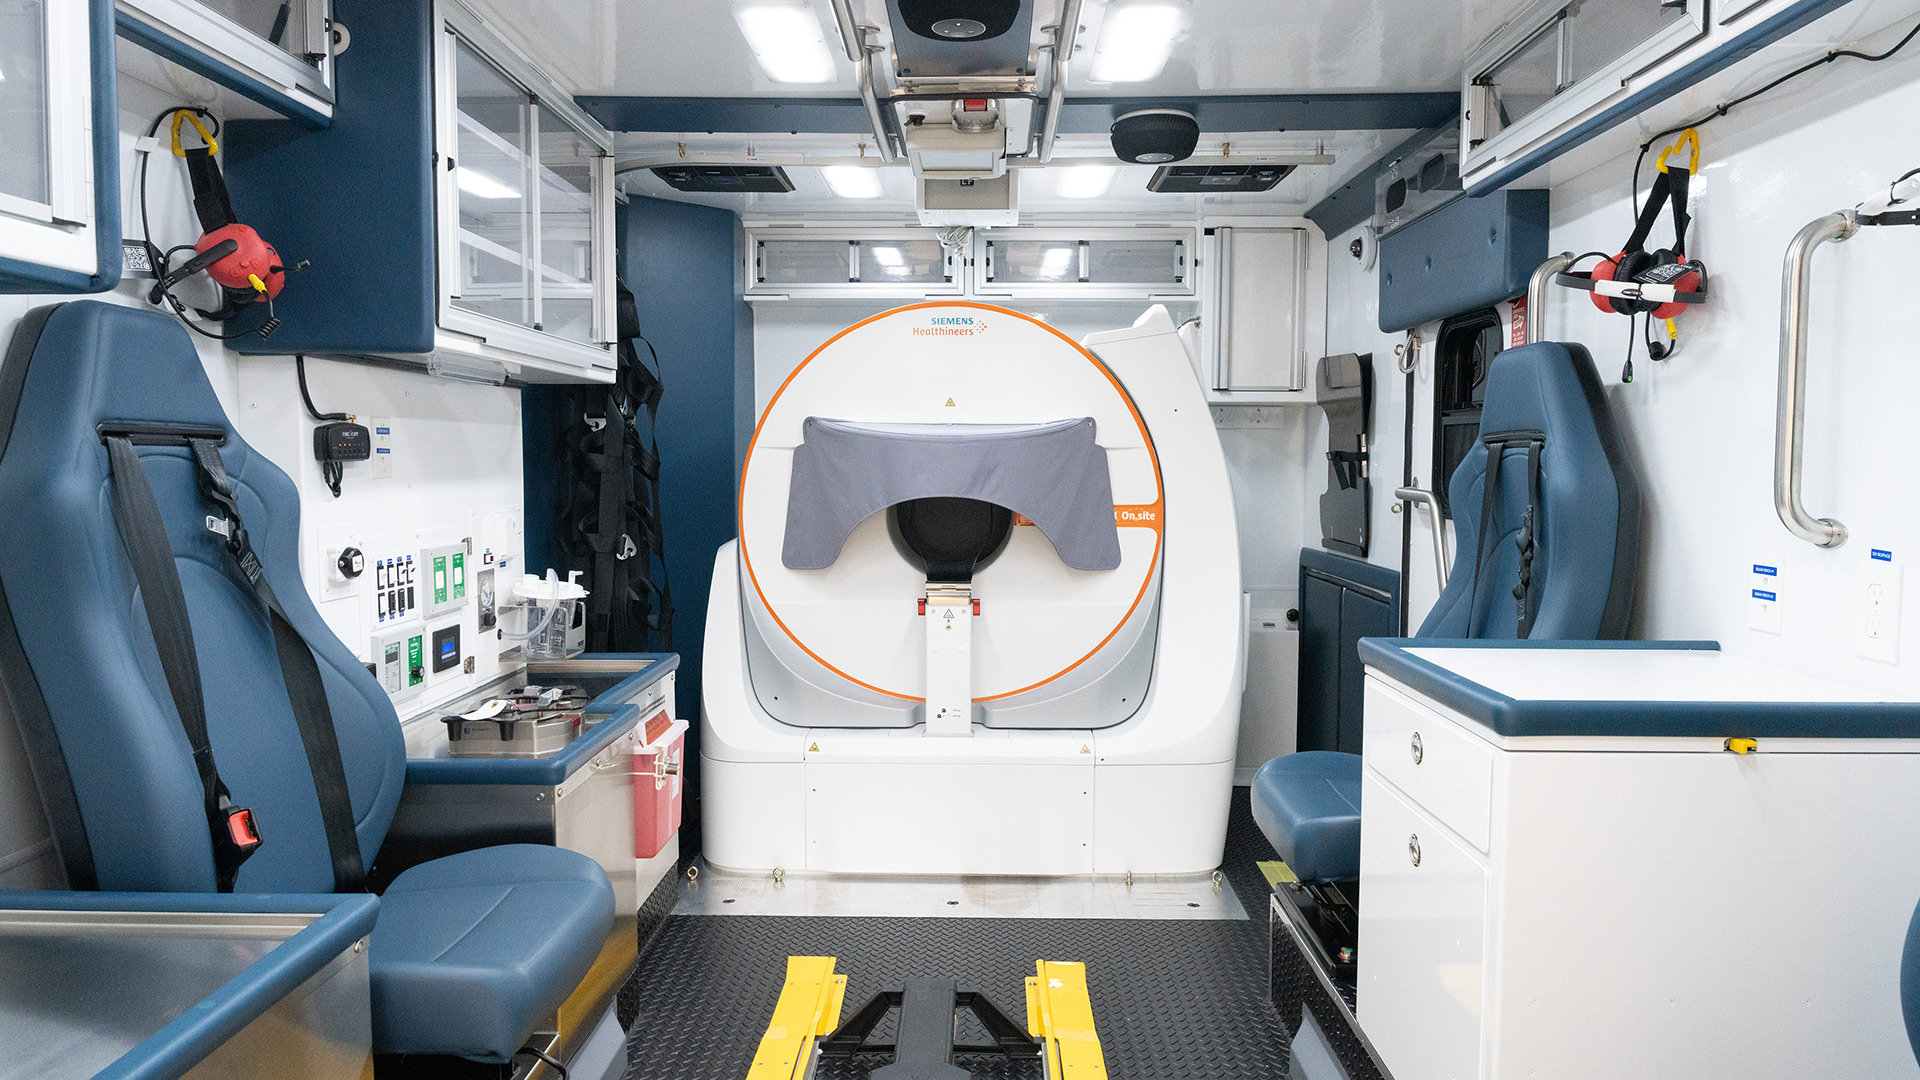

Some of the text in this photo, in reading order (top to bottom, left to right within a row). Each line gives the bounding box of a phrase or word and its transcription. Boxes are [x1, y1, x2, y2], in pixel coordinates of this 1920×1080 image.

[931, 317, 974, 325] SIEMENS
[912, 326, 974, 336] Healthineers
[1121, 511, 1156, 520] On.site
